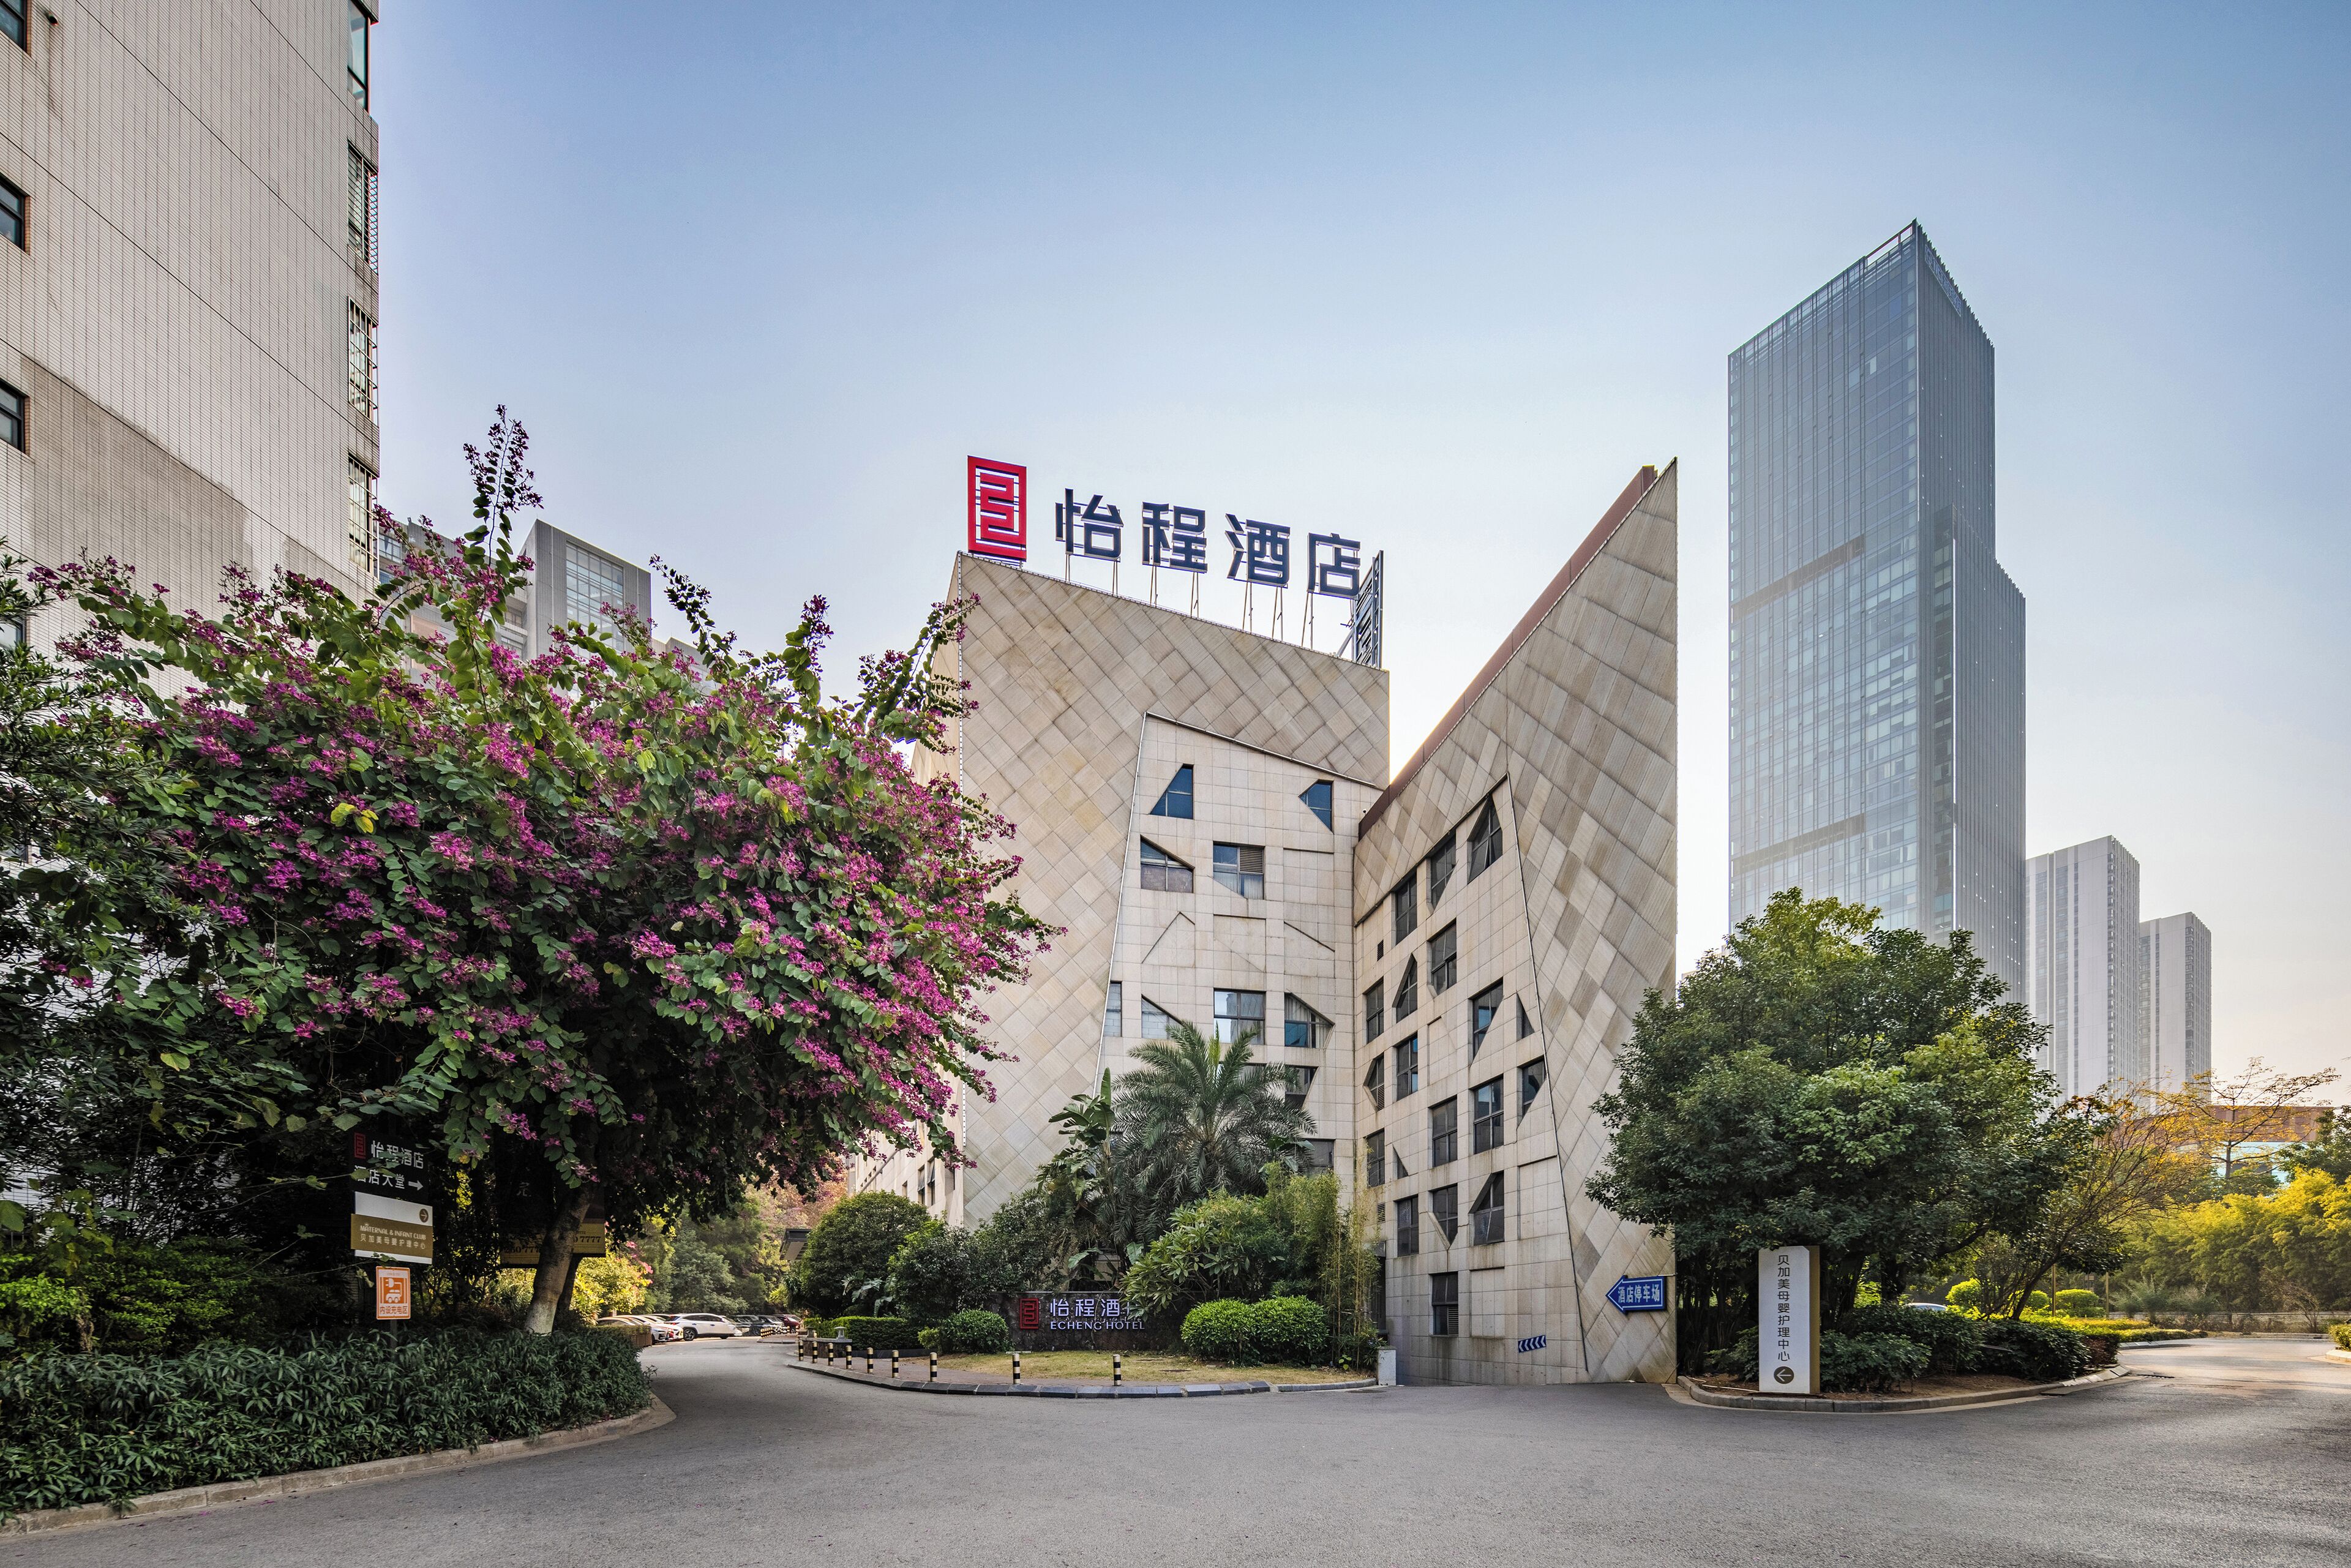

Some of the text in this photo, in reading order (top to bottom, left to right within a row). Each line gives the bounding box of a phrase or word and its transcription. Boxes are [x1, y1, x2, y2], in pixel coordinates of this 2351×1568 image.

[1056, 488, 1361, 599] 怡程酒店
[359, 1225, 389, 1235] MATERNAL
[1618, 1283, 1660, 1304] 酒店停车场
[1777, 1255, 1790, 1362] 贝加美母婴护理中心
[1050, 1321, 1146, 1330] ECHENG HOTEL
